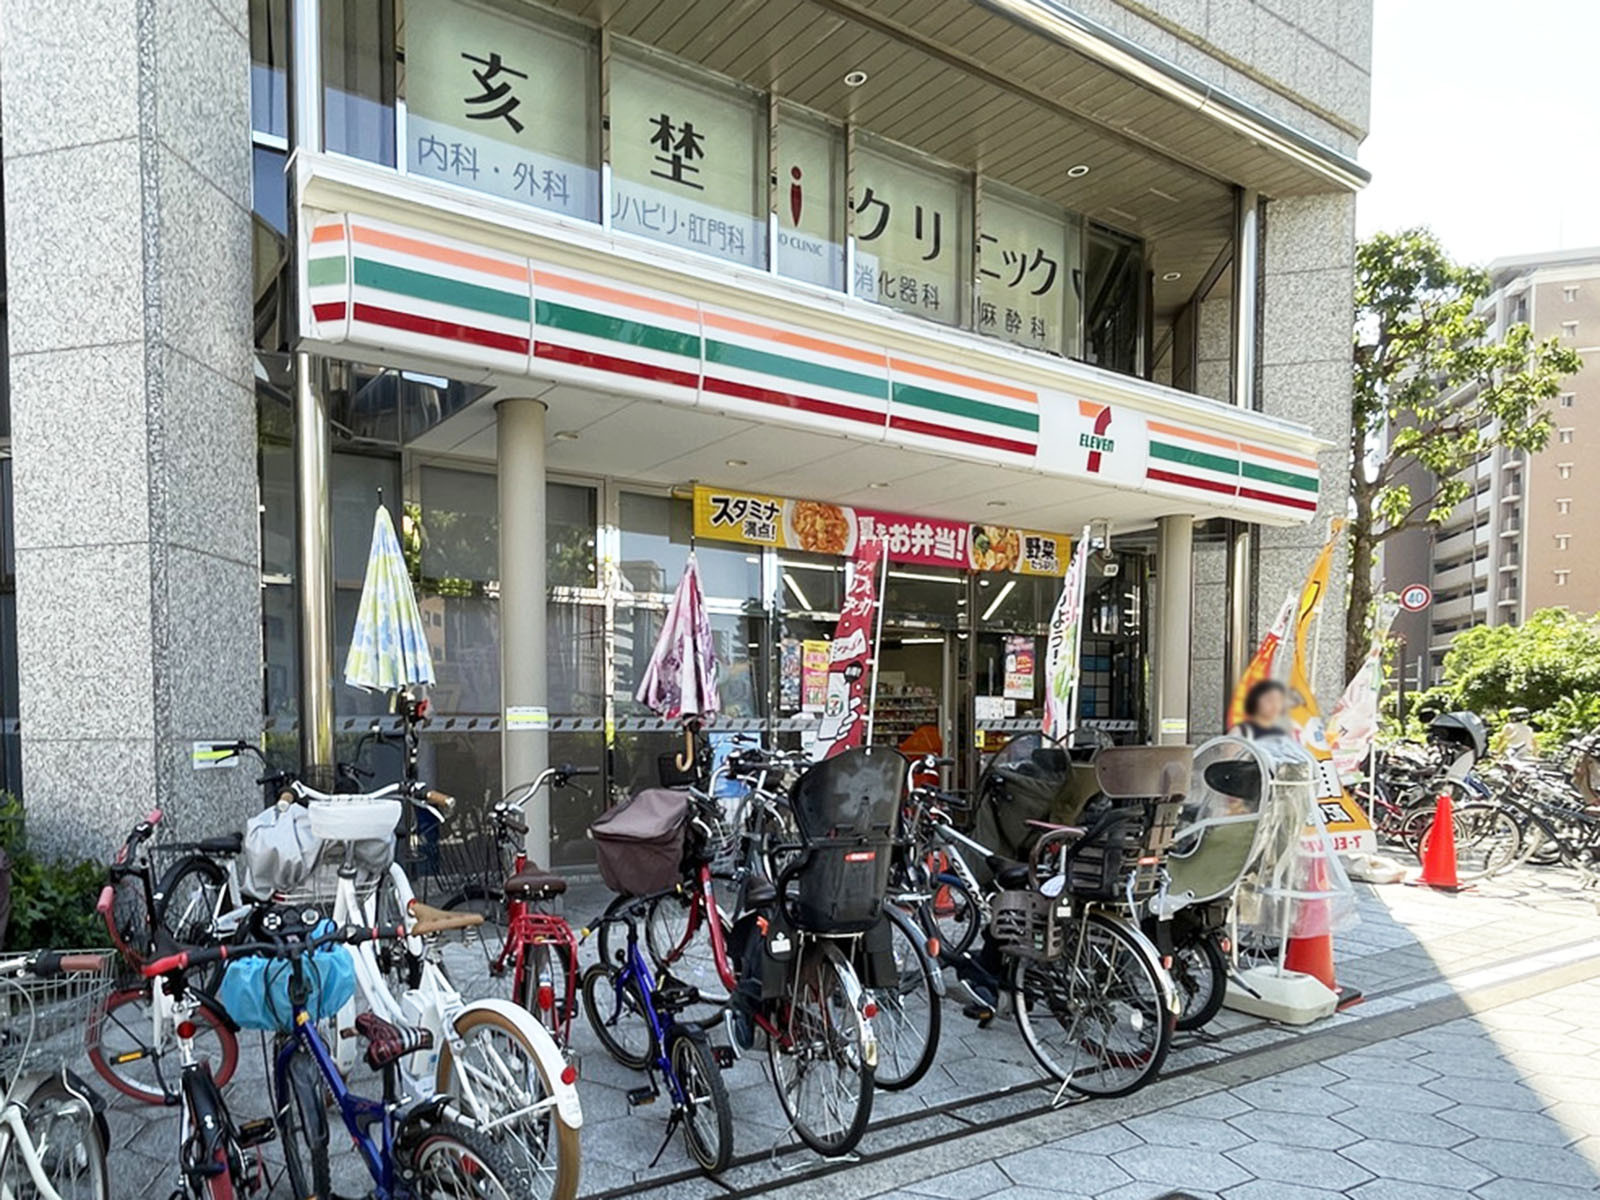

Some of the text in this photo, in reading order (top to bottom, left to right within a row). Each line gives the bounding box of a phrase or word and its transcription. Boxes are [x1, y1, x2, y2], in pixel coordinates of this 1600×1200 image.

[461, 52, 528, 134] 亥
[649, 113, 705, 191] 埜
[417, 135, 571, 206] 内科・外科
[855, 265, 940, 311] 消化器科
[979, 302, 1047, 342] 麻酔科
[790, 236, 823, 257] CLINIC
[711, 495, 780, 525] スタミナ
[1026, 536, 1056, 560] 野菜
[1407, 591, 1424, 604] 40
